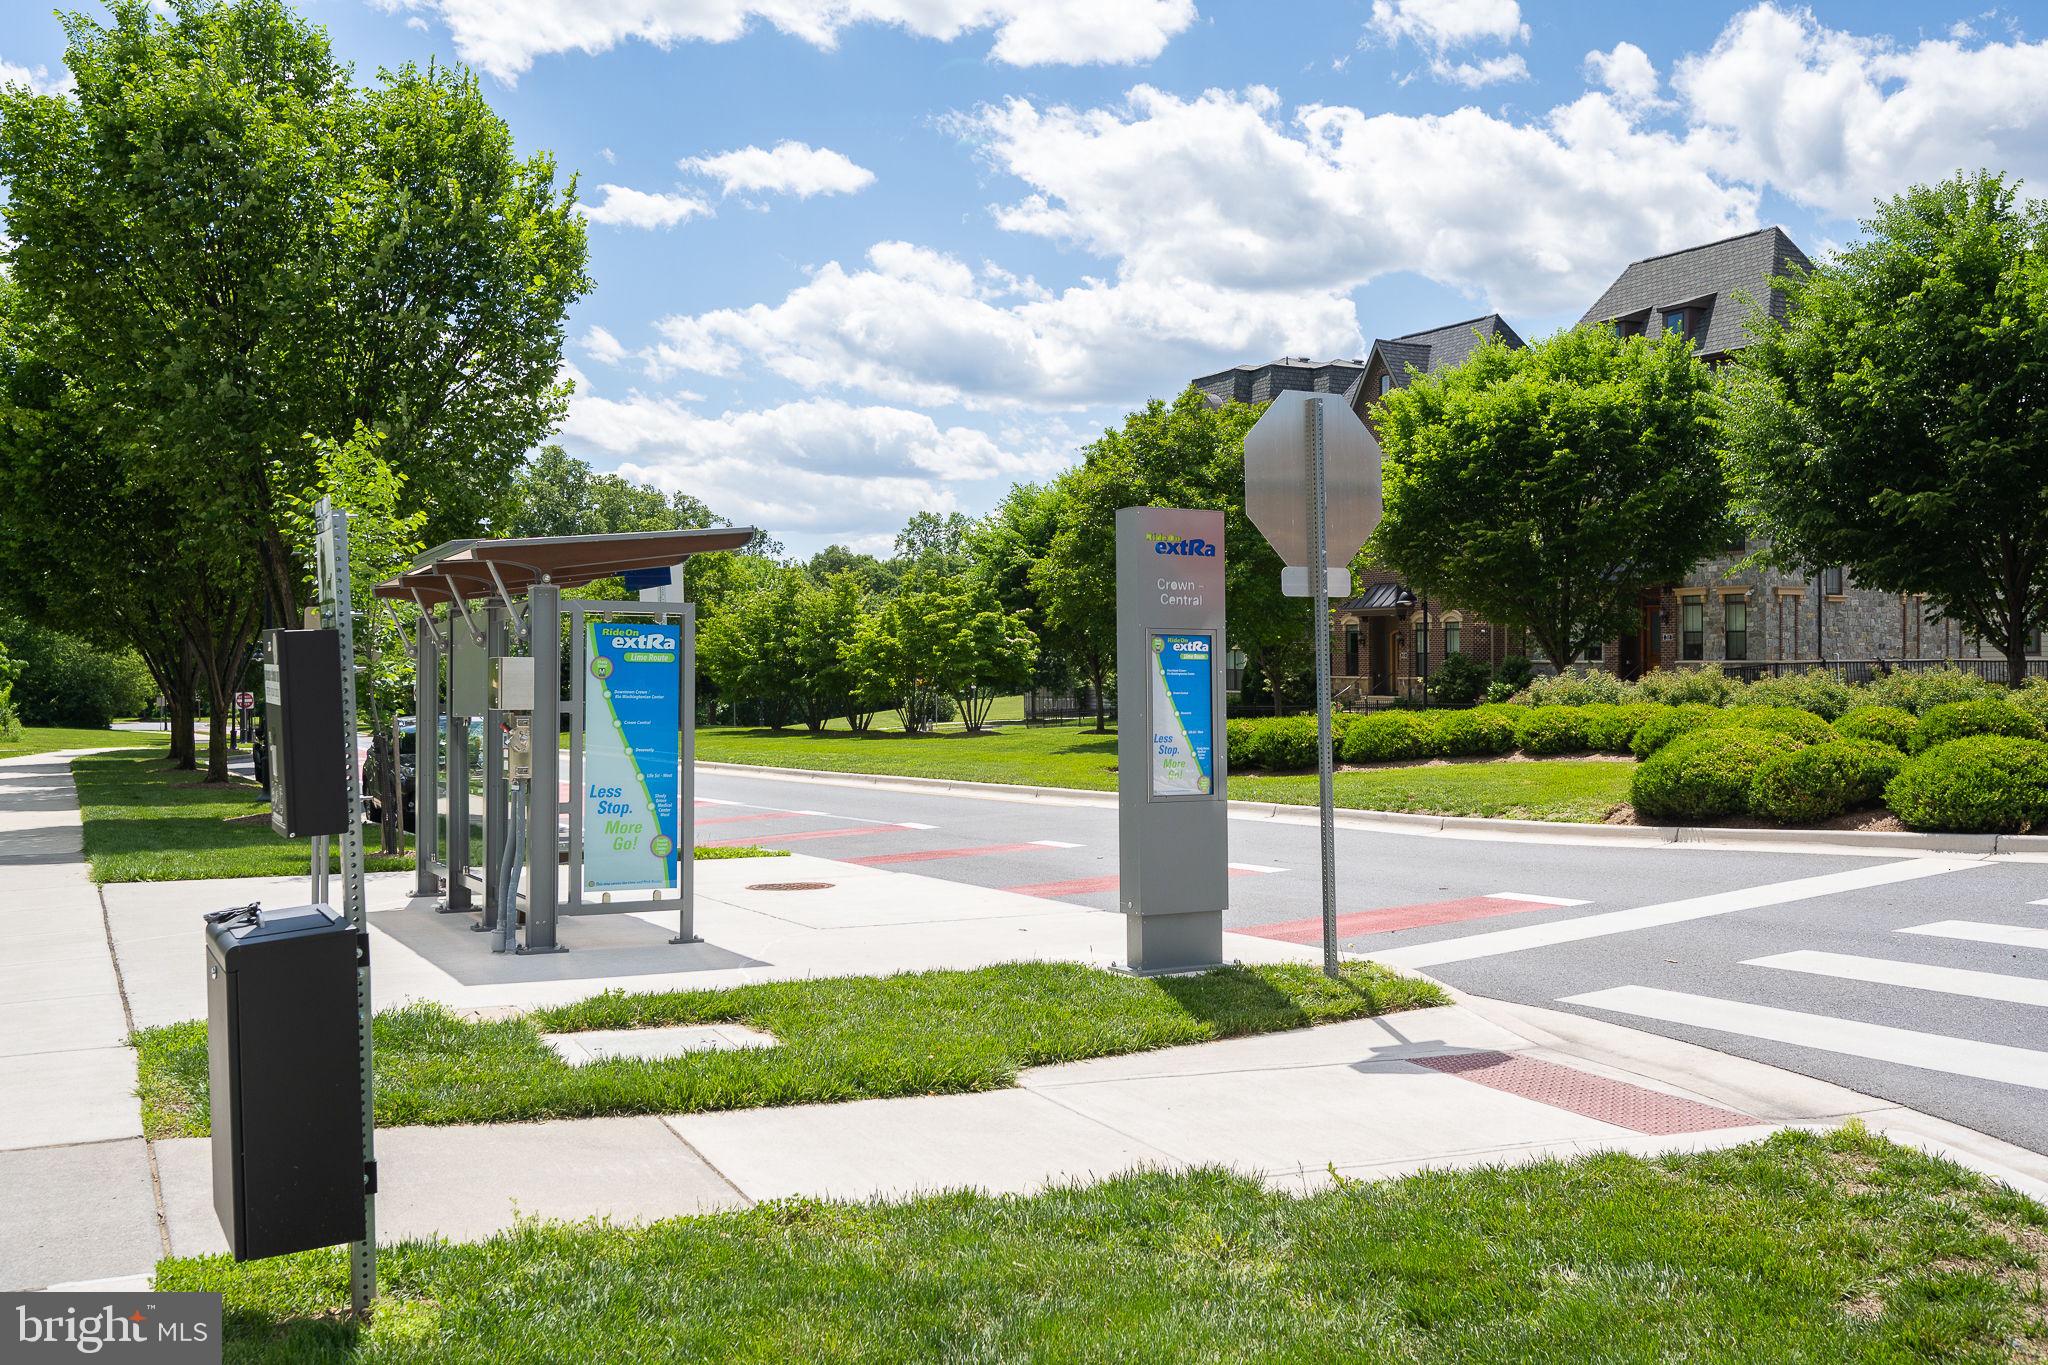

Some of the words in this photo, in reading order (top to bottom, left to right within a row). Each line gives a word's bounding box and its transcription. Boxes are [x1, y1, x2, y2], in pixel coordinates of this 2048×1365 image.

[1154, 538, 1216, 557] extRa
[1157, 578, 1195, 590] Crown
[1160, 593, 1203, 606] Central
[602, 628, 625, 636] Ride
[612, 633, 675, 650] extRa
[1173, 641, 1209, 652] extRa
[649, 654, 669, 662] Route
[1154, 734, 1173, 743] Less
[1159, 745, 1180, 756] Stop.
[1163, 758, 1186, 769] More
[589, 784, 622, 798] Less
[597, 800, 633, 817] Stop.
[605, 820, 643, 834] More
[613, 836, 638, 851] Go!
